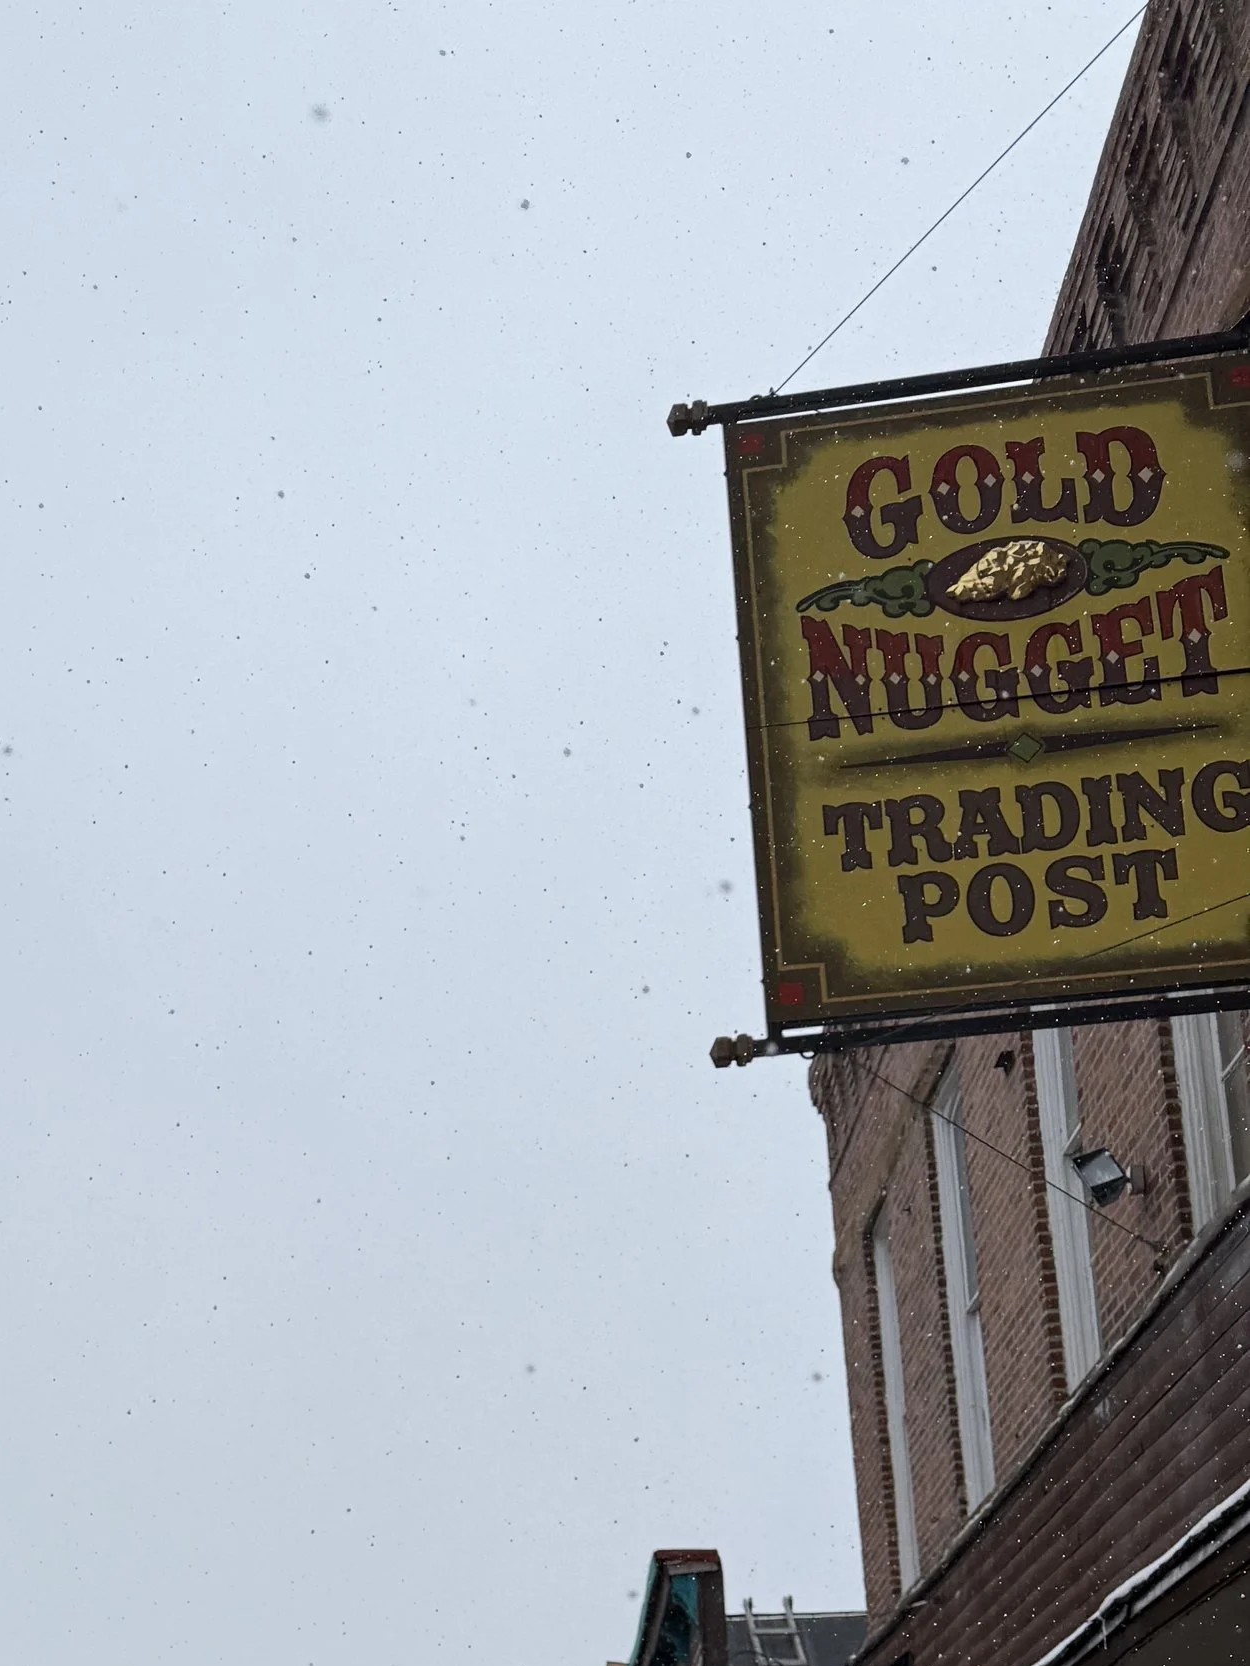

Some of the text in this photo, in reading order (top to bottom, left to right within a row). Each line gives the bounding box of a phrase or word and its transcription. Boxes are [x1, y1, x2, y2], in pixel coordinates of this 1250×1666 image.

[843, 425, 1167, 560] GOLD
[800, 565, 1228, 742] NUGGET
[823, 758, 1250, 873] TRADING
[897, 847, 1179, 944] POST
